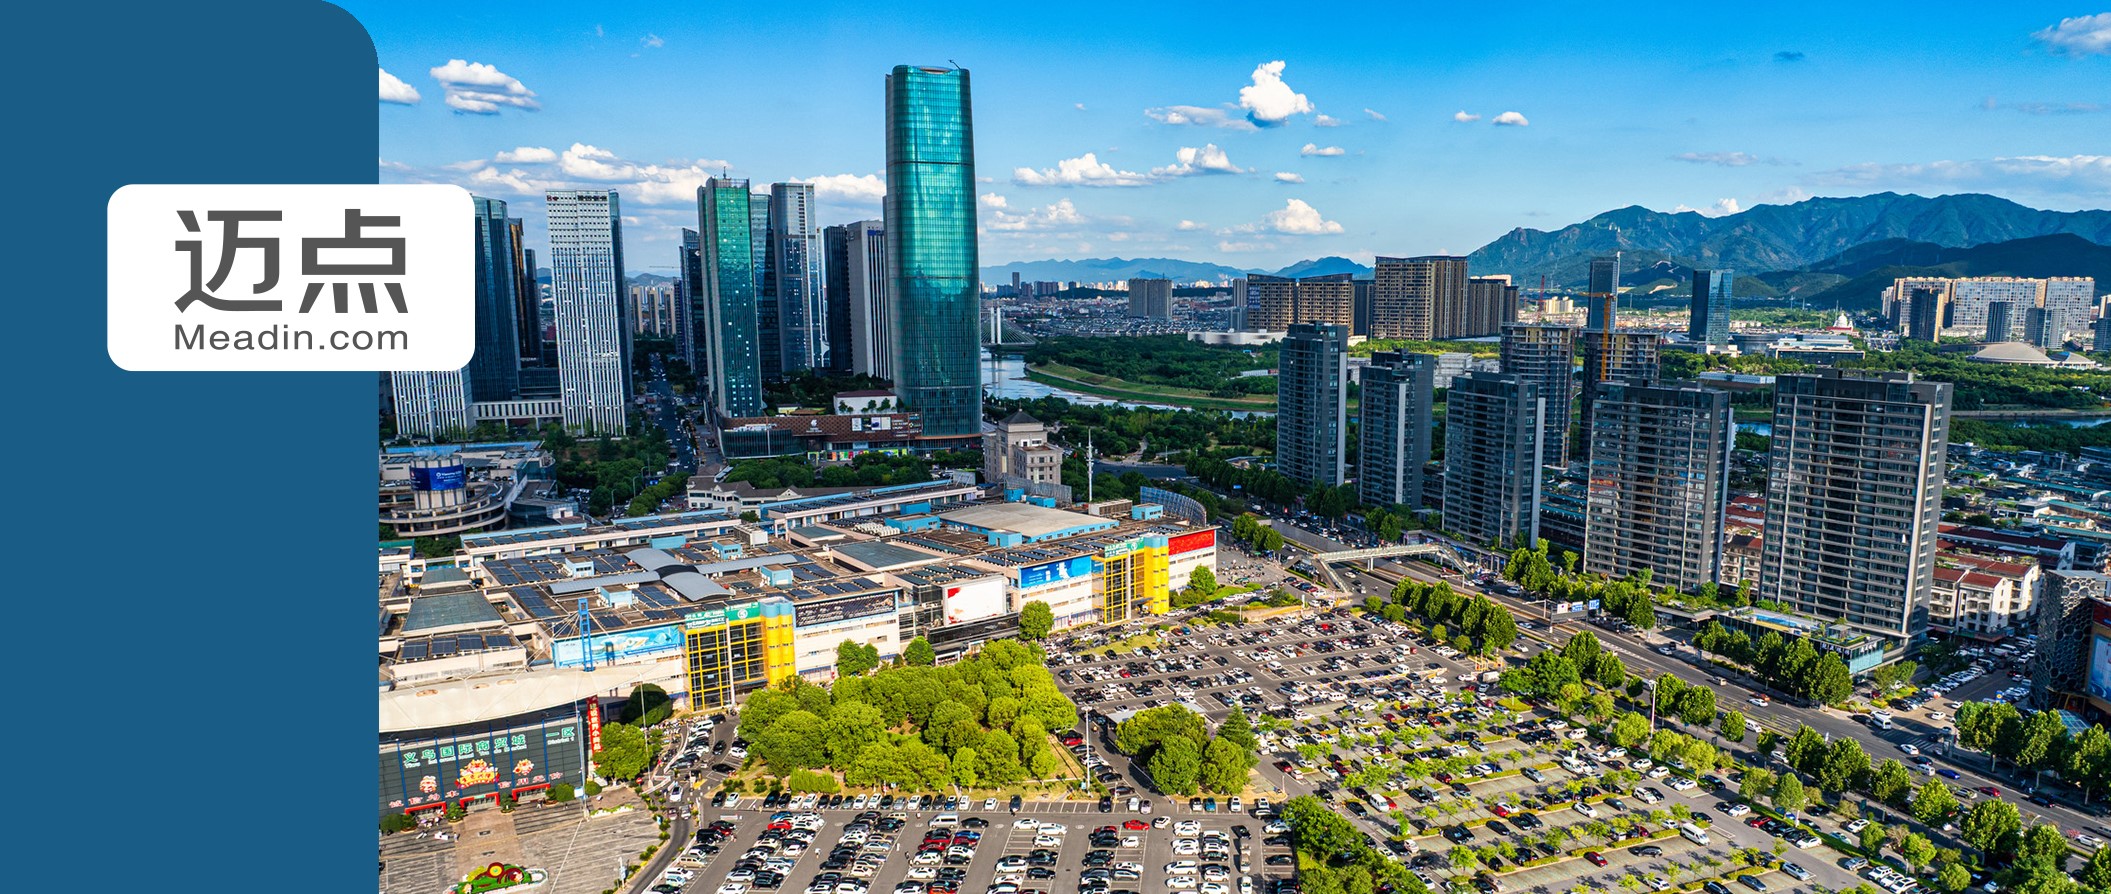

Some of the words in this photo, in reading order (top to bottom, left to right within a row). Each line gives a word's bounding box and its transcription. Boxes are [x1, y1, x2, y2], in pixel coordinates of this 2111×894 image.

[403, 734, 526, 764] 义乌国际商贸城
[545, 726, 575, 739] 一区
